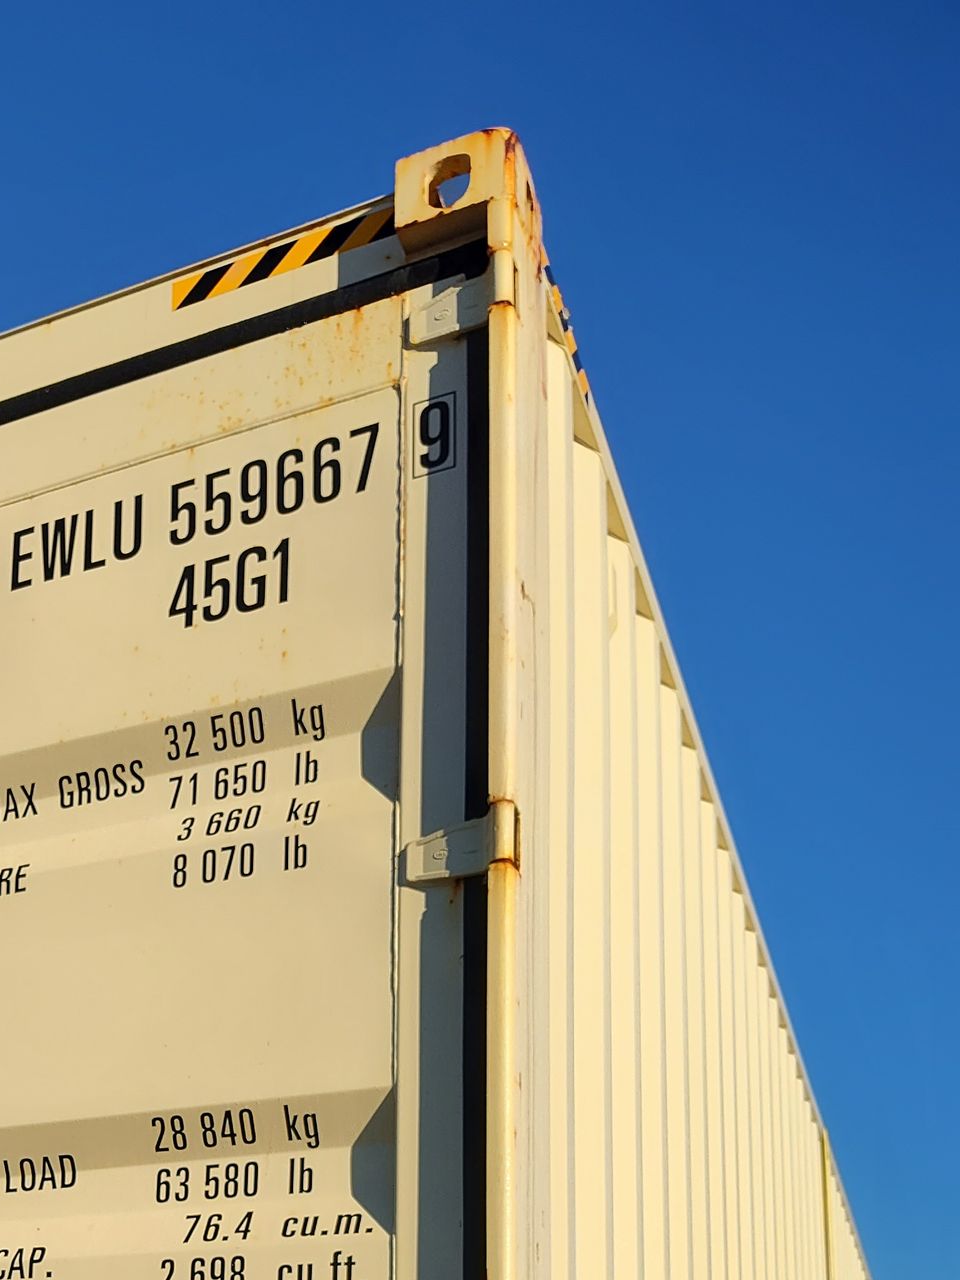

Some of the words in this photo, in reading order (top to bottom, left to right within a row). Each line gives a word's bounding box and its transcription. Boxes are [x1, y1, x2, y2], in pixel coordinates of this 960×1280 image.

[9, 493, 144, 592] EWLU
[168, 421, 381, 546] 559667
[419, 401, 451, 470] 9
[168, 537, 292, 629] 45G1
[164, 720, 200, 761] 32
[210, 706, 265, 752] 500
[290, 698, 326, 742] kg
[58, 759, 145, 809] GROSS
[168, 772, 198, 810] 71
[214, 759, 267, 801] 650
[294, 750, 319, 786] lb
[176, 816, 195, 842] 3
[205, 804, 262, 837] 660
[286, 797, 321, 826] kg
[172, 853, 188, 889] 8
[201, 842, 255, 884] 070
[283, 834, 308, 872] lb
[151, 1114, 188, 1153] 28
[199, 1108, 257, 1148] 840
[283, 1104, 320, 1150] kg
[155, 1166, 190, 1204] 63
[204, 1161, 259, 1200] 580
[288, 1157, 313, 1195] lb
[182, 1210, 254, 1244] 76.4
[281, 1211, 375, 1239] cu.m.
